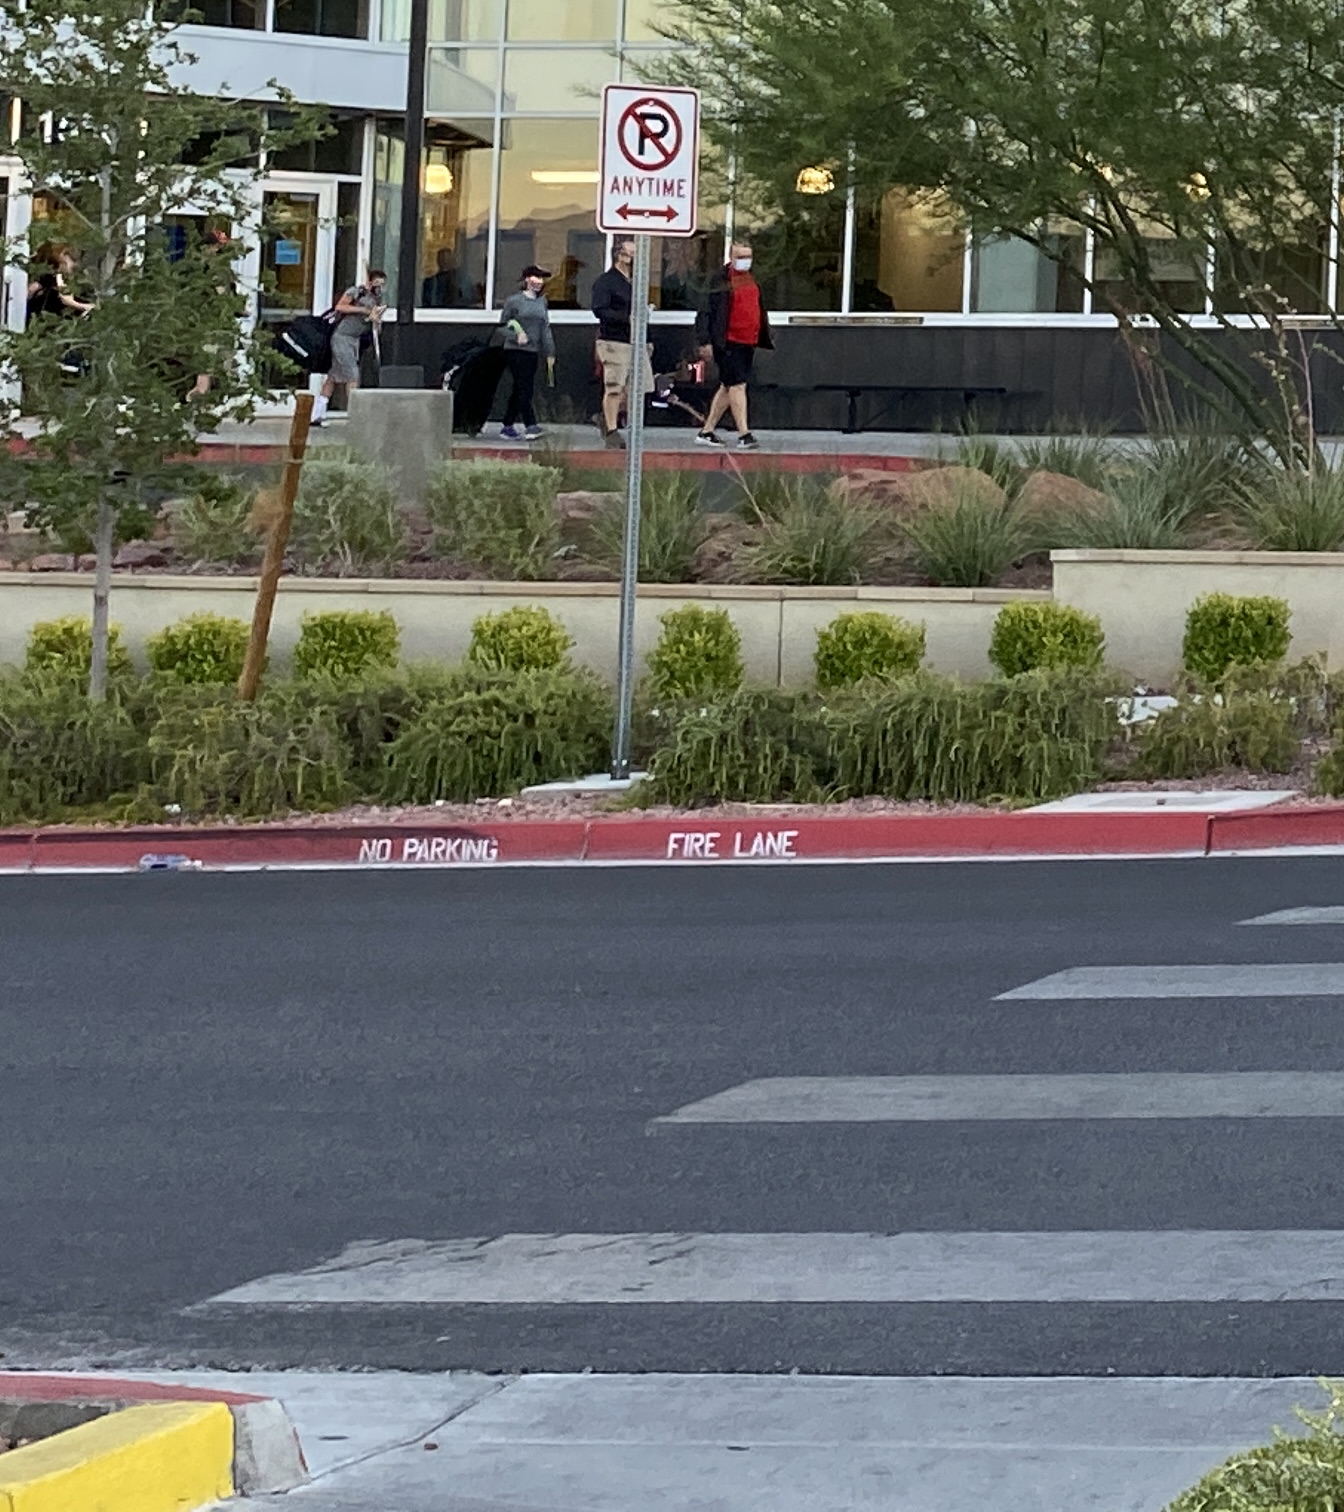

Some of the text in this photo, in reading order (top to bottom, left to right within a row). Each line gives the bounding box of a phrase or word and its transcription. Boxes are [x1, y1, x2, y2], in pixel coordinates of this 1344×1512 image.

[610, 175, 686, 199] ANYTIME
[359, 837, 498, 863] NO PARKING
[667, 830, 799, 859] FIRE LANE
